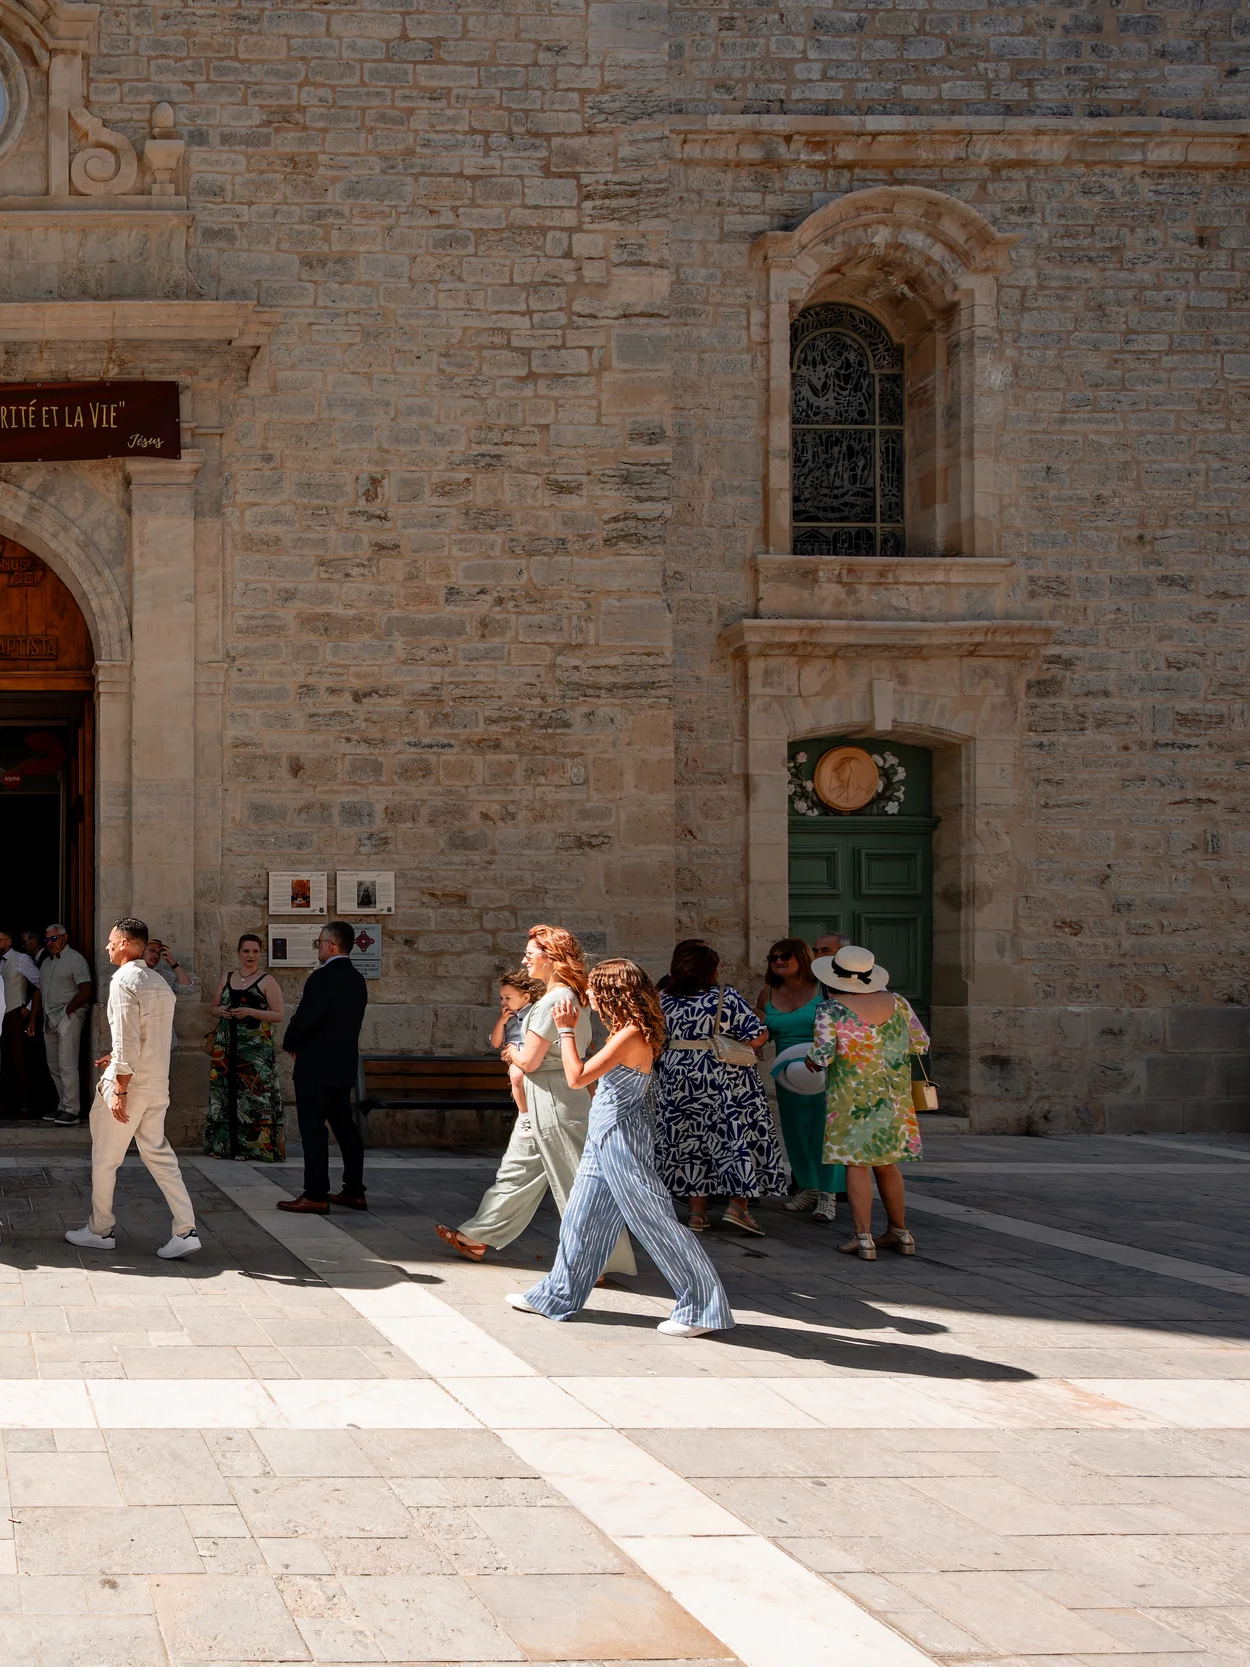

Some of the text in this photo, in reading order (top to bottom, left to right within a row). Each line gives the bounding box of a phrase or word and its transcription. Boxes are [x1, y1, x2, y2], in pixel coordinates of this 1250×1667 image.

[127, 433, 165, 449] Jésus
[14, 571, 38, 584] DEI
[4, 775, 21, 783] Alpha
